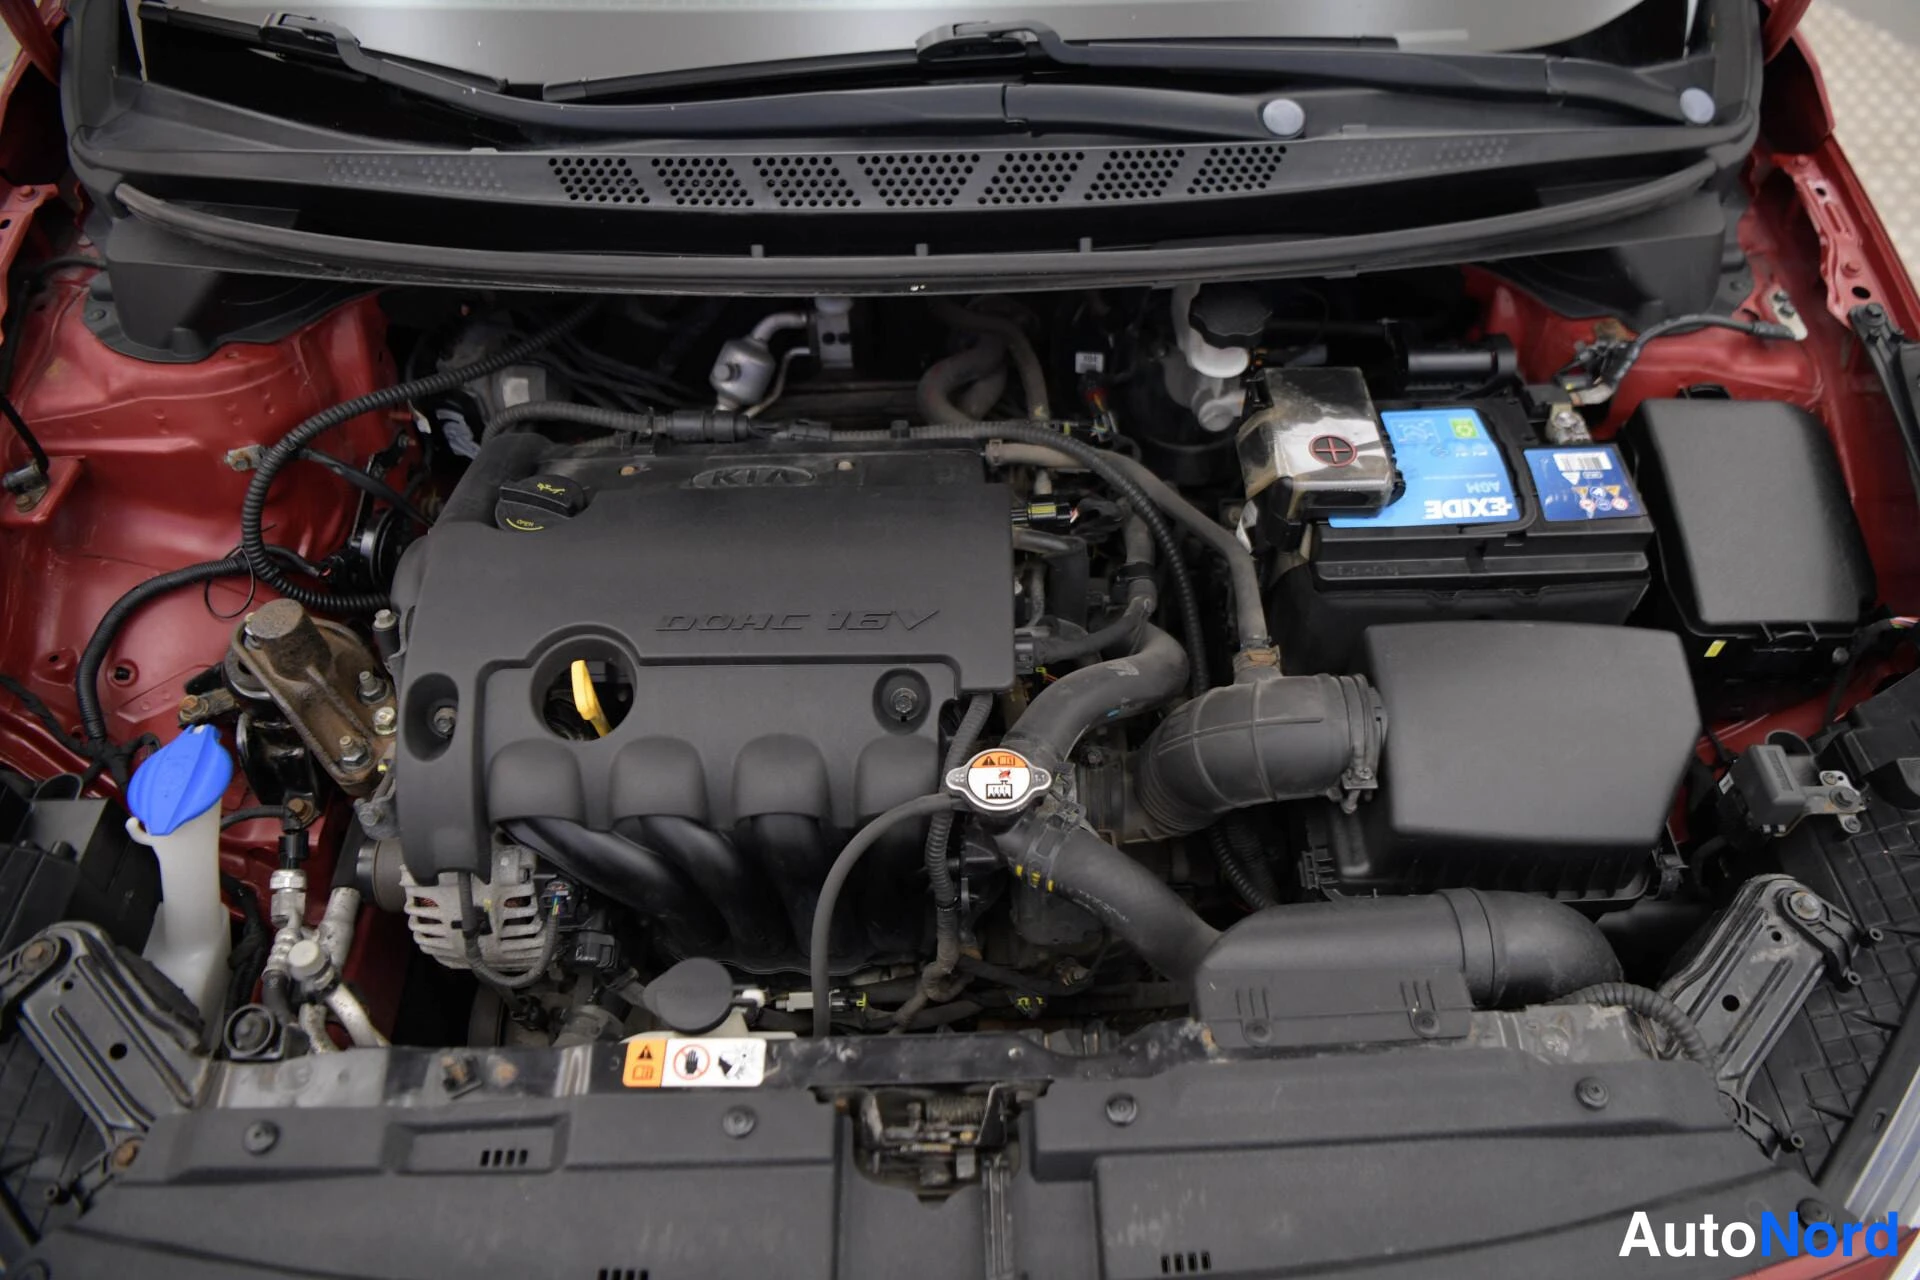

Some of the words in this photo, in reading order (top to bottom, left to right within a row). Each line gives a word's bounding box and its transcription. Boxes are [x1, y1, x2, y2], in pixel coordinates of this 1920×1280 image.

[712, 469, 790, 485] KIA
[1422, 497, 1512, 519] EXIDE
[656, 614, 810, 631] DOHC
[827, 610, 939, 631] 16V
